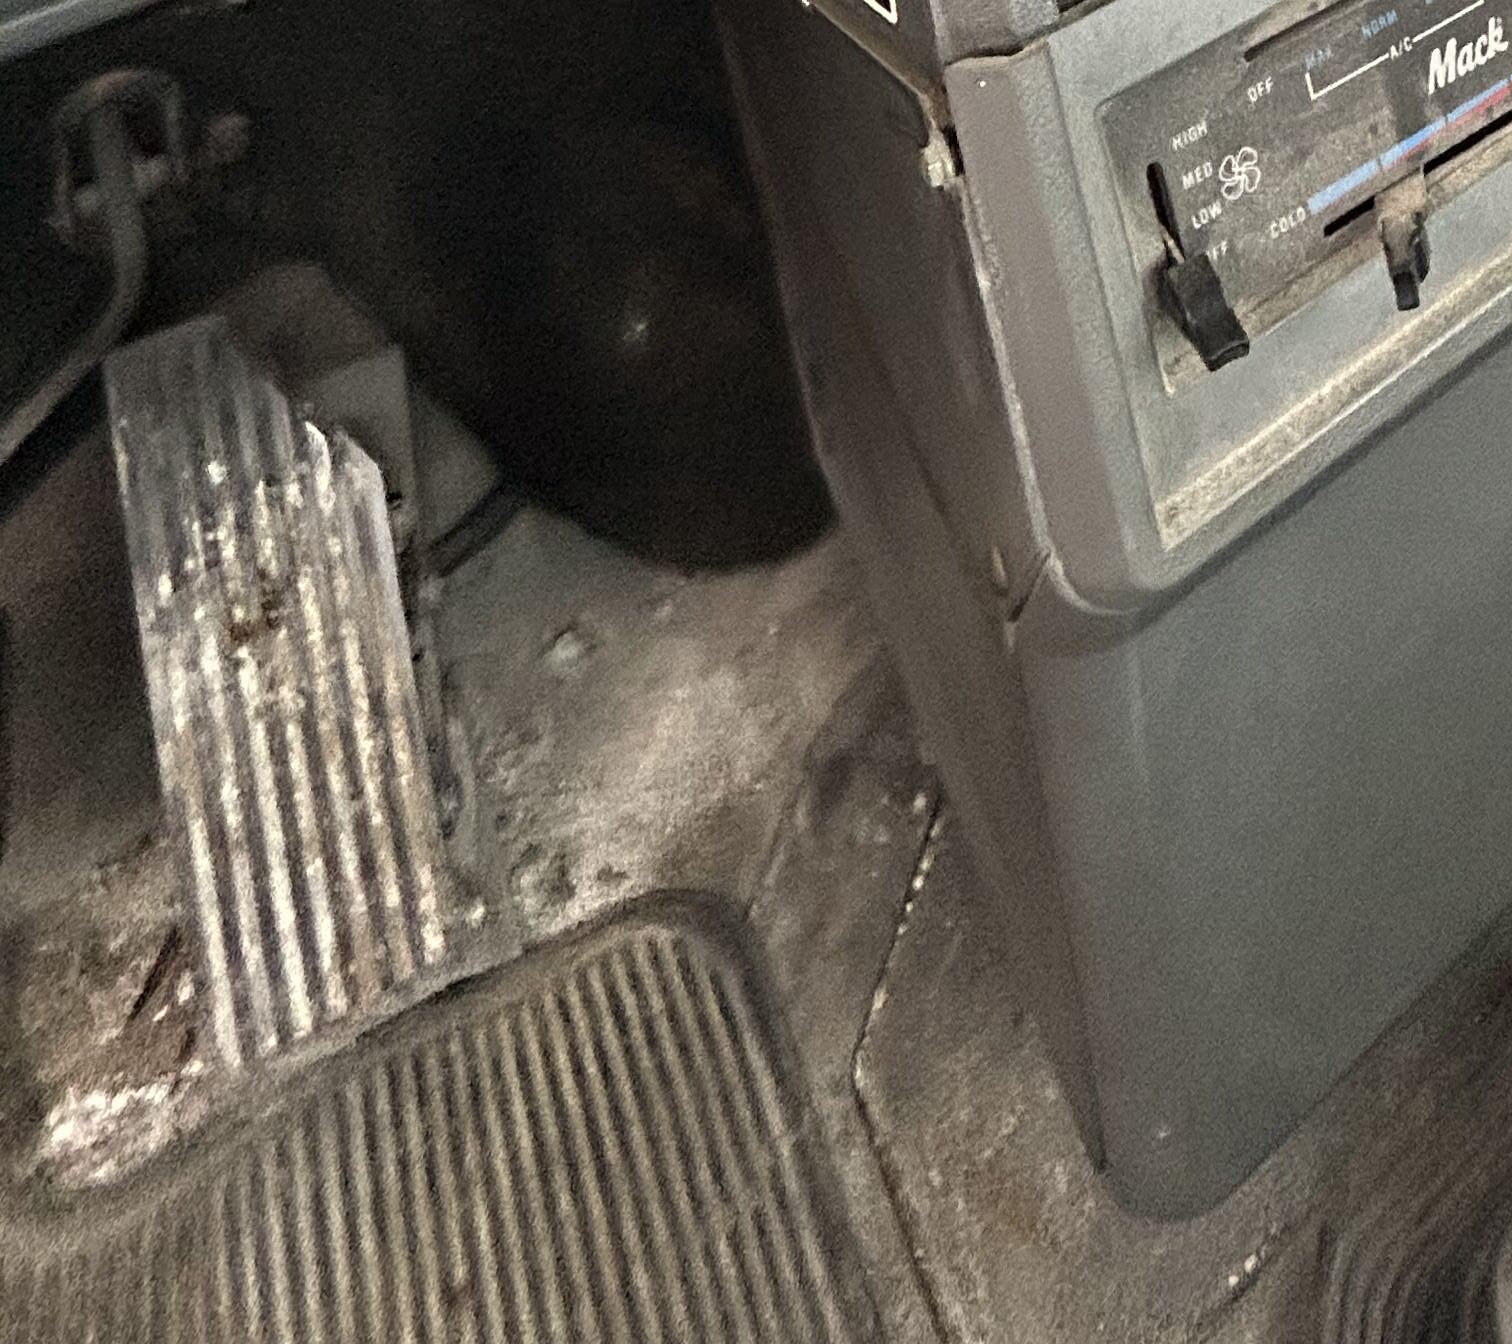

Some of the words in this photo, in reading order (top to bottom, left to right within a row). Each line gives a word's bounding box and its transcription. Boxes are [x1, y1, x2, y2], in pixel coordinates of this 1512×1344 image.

[1361, 11, 1399, 40] NORM
[1389, 36, 1413, 60] A/C
[1428, 16, 1509, 95] Mack
[1247, 76, 1274, 103] OFF
[1171, 120, 1208, 151] HIGH
[1181, 162, 1214, 190] MED
[1191, 202, 1223, 230] LOW
[1269, 206, 1307, 239] COLD
